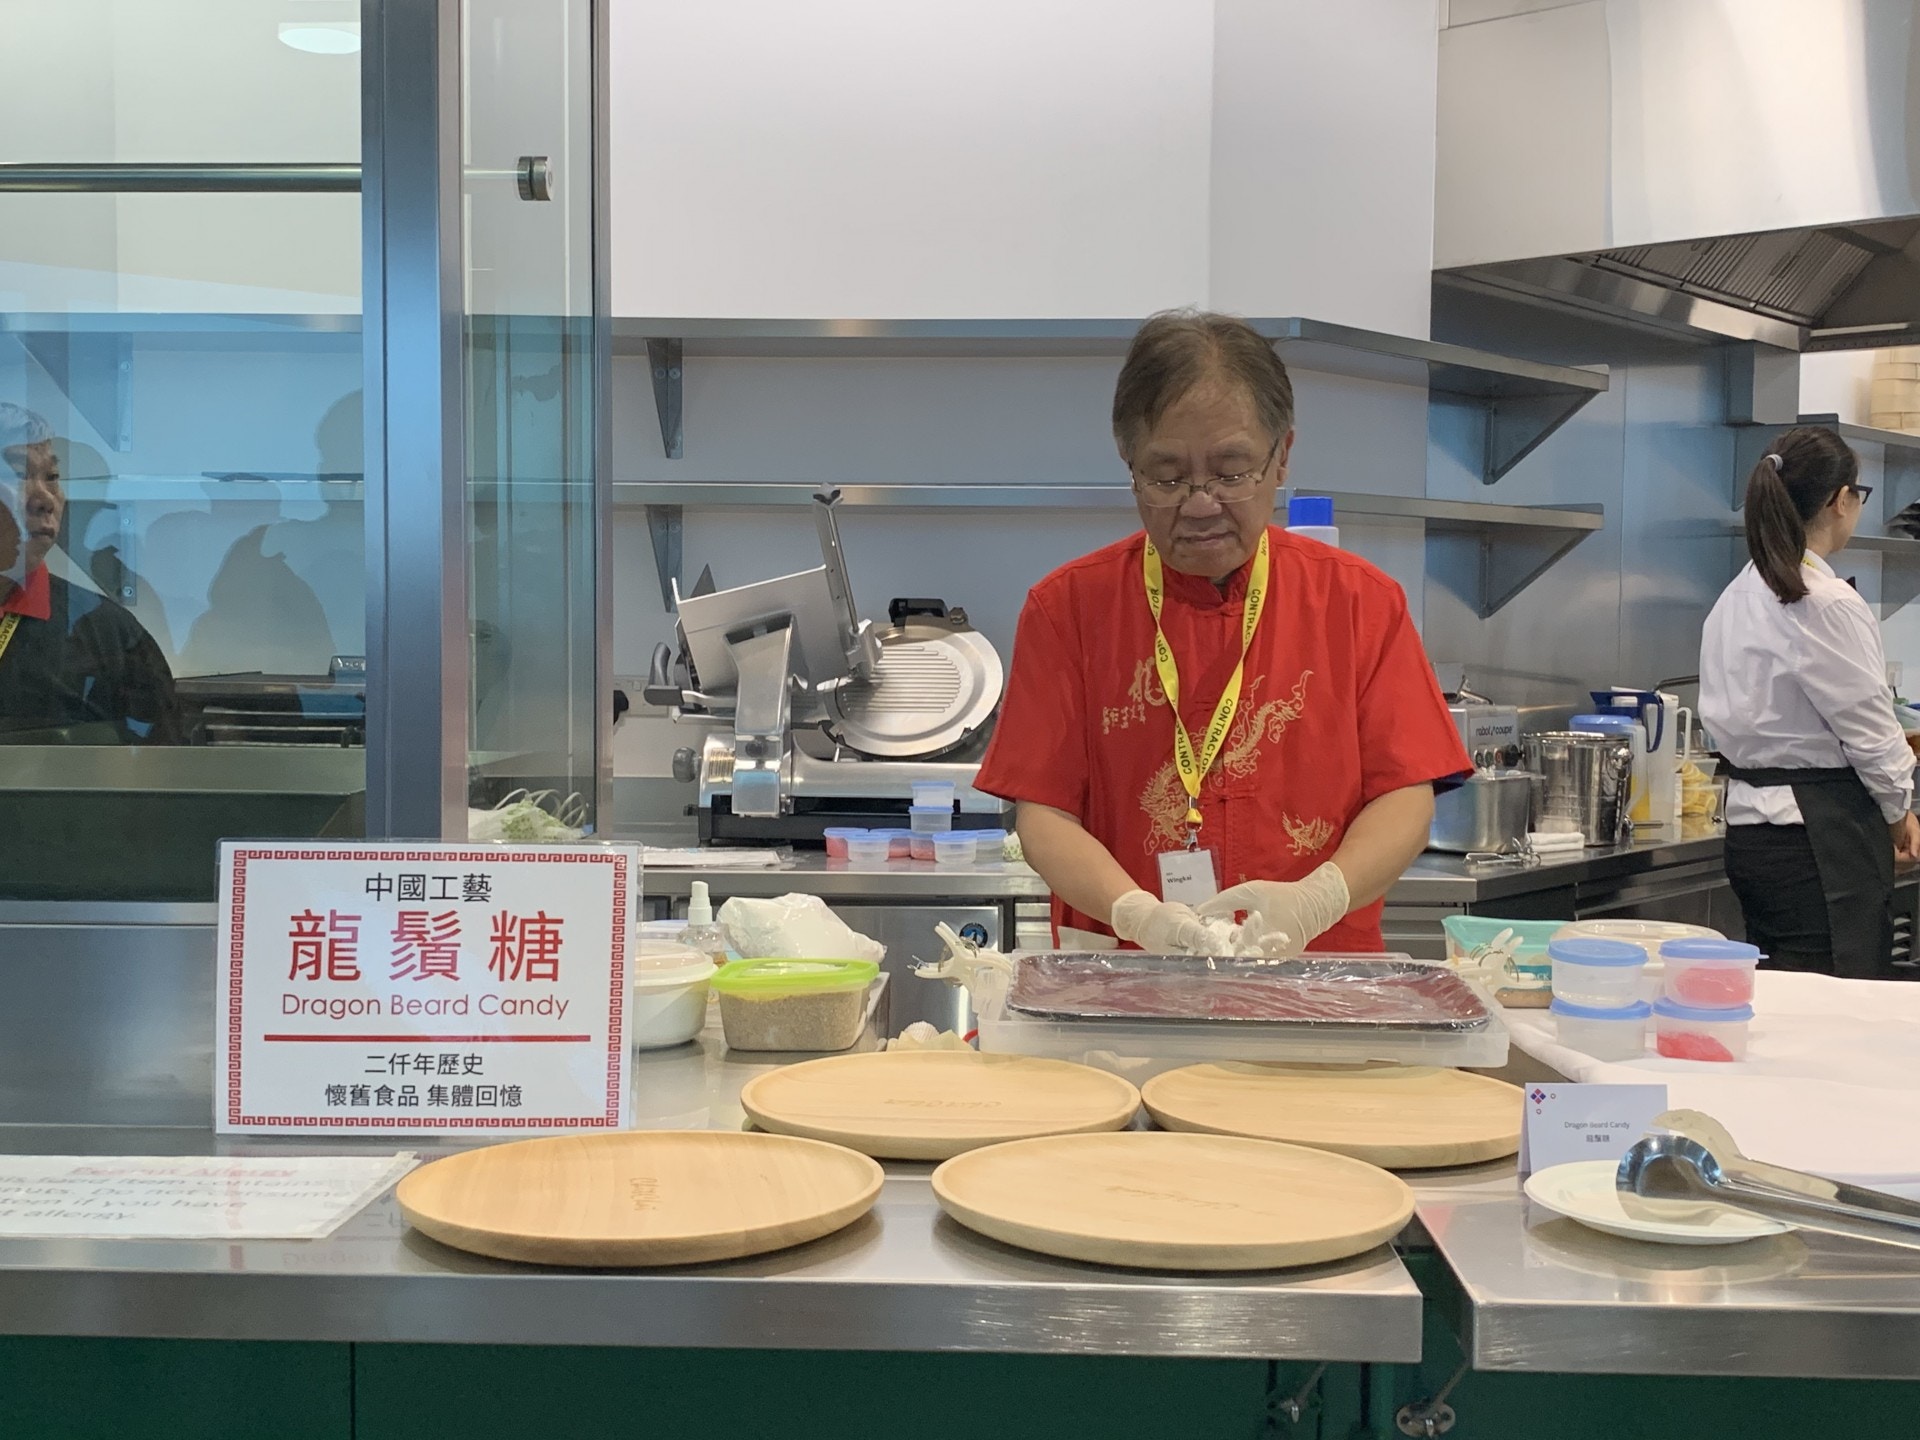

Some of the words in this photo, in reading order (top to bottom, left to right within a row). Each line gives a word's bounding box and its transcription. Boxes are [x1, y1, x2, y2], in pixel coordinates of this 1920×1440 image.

[365, 873, 492, 903] 中國工藝
[288, 909, 564, 982] 龍鬚糖
[282, 994, 381, 1020] Dragon
[390, 994, 469, 1015] Beard
[479, 994, 570, 1020] Candy
[364, 1053, 484, 1076] 二仟年歷史
[325, 1085, 420, 1108] 懷舊食品
[427, 1085, 523, 1108] 集體回憶
[1564, 1121, 1588, 1129] Dragon
[1610, 1121, 1630, 1129] Candy
[103, 1200, 160, 1208] you
[171, 1199, 247, 1208] have
